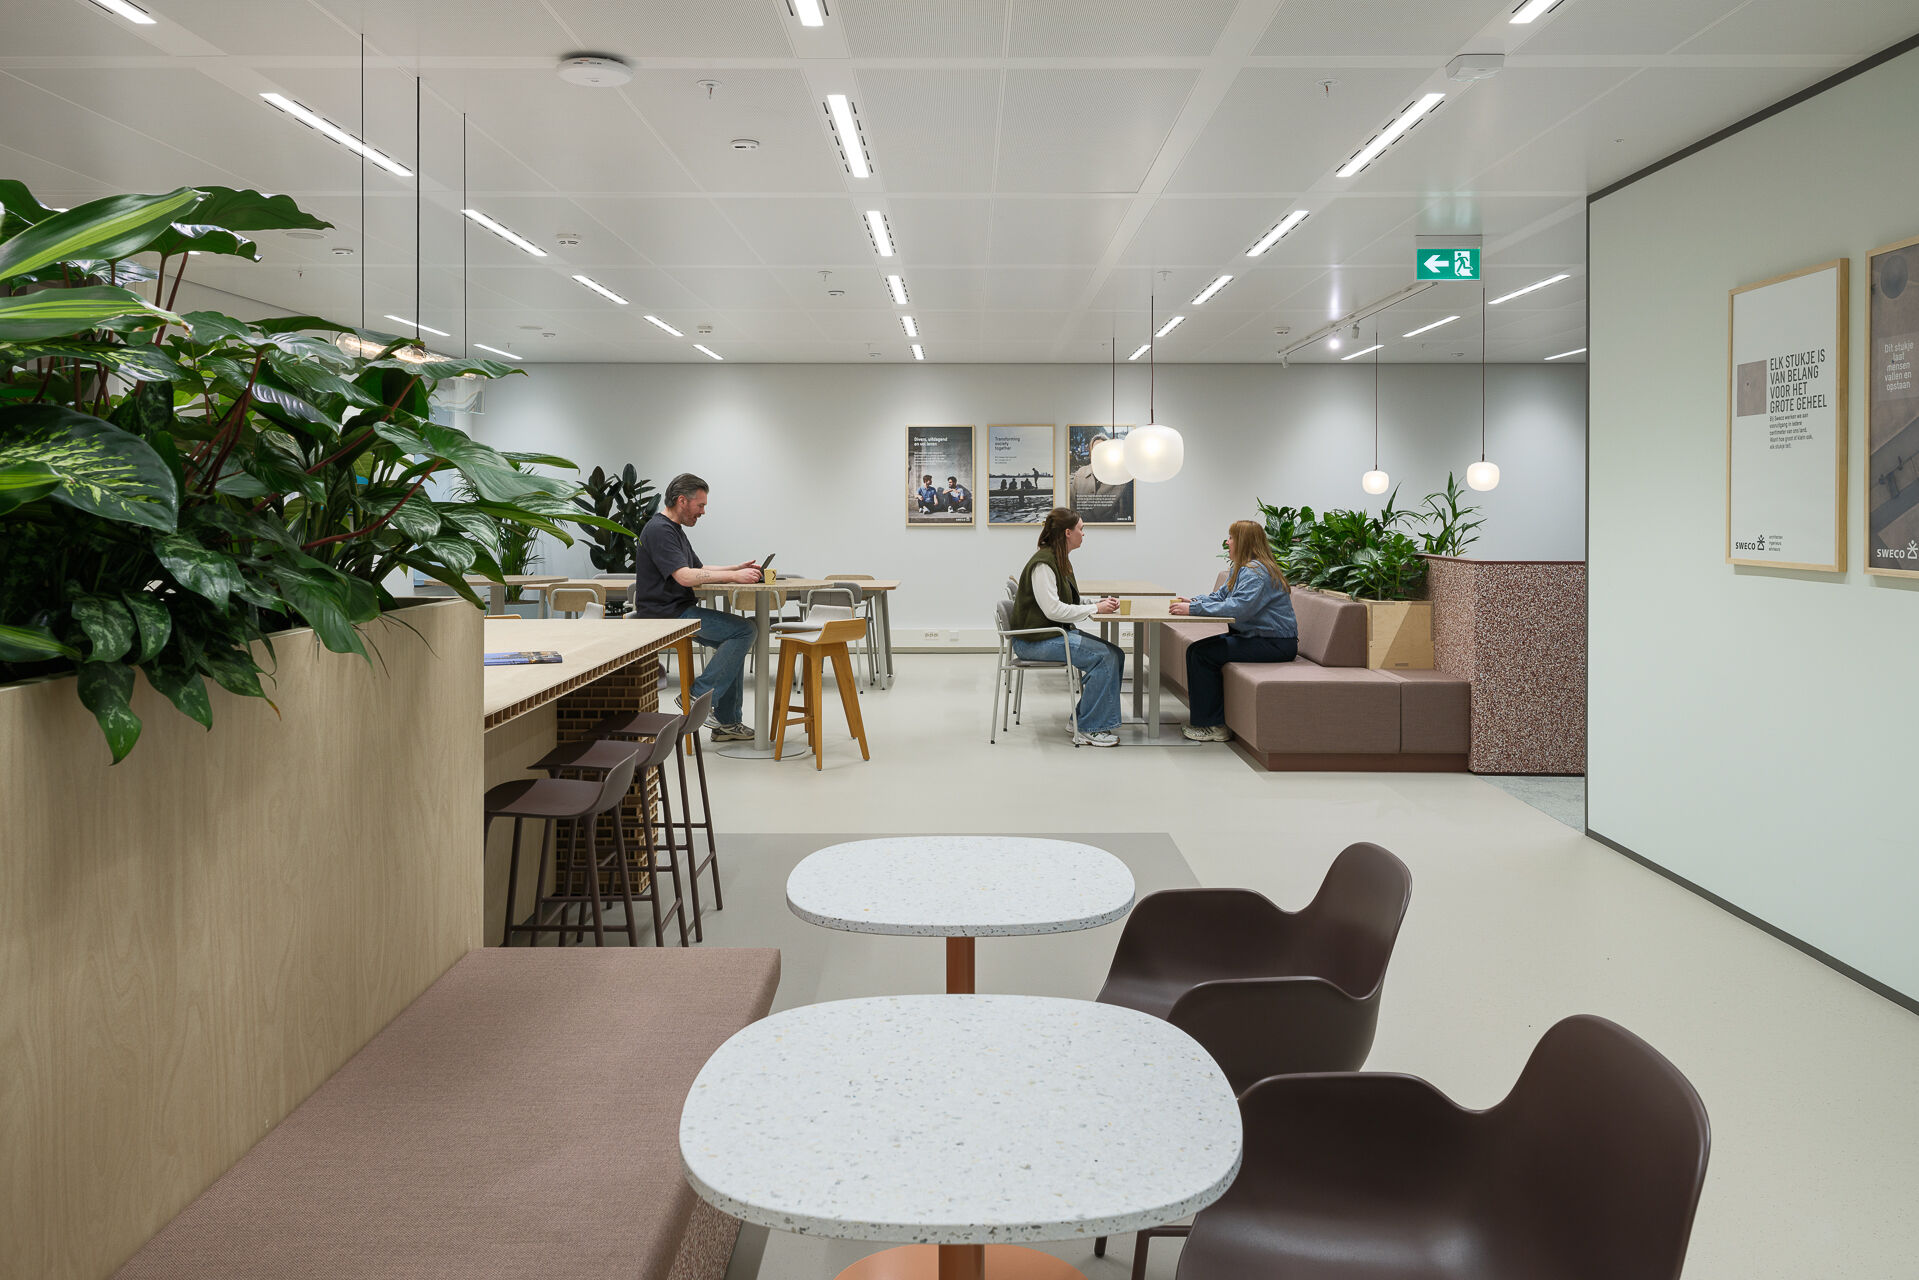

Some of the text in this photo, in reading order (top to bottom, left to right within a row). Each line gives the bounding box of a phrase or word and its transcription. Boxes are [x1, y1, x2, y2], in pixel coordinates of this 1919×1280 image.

[1884, 341, 1914, 353] Dit stukje
[1770, 348, 1826, 371] ELK STUKJE IS
[1886, 361, 1911, 372] mensen
[1770, 365, 1819, 385] VAN BELANG
[1884, 371, 1912, 381] vallen en
[1770, 381, 1808, 399] VOOR HET
[1886, 381, 1911, 392] opstaan
[1770, 394, 1828, 413] GROTE GEHEEL
[1735, 541, 1756, 550] SWECO
[1876, 548, 1905, 559] SWECO
